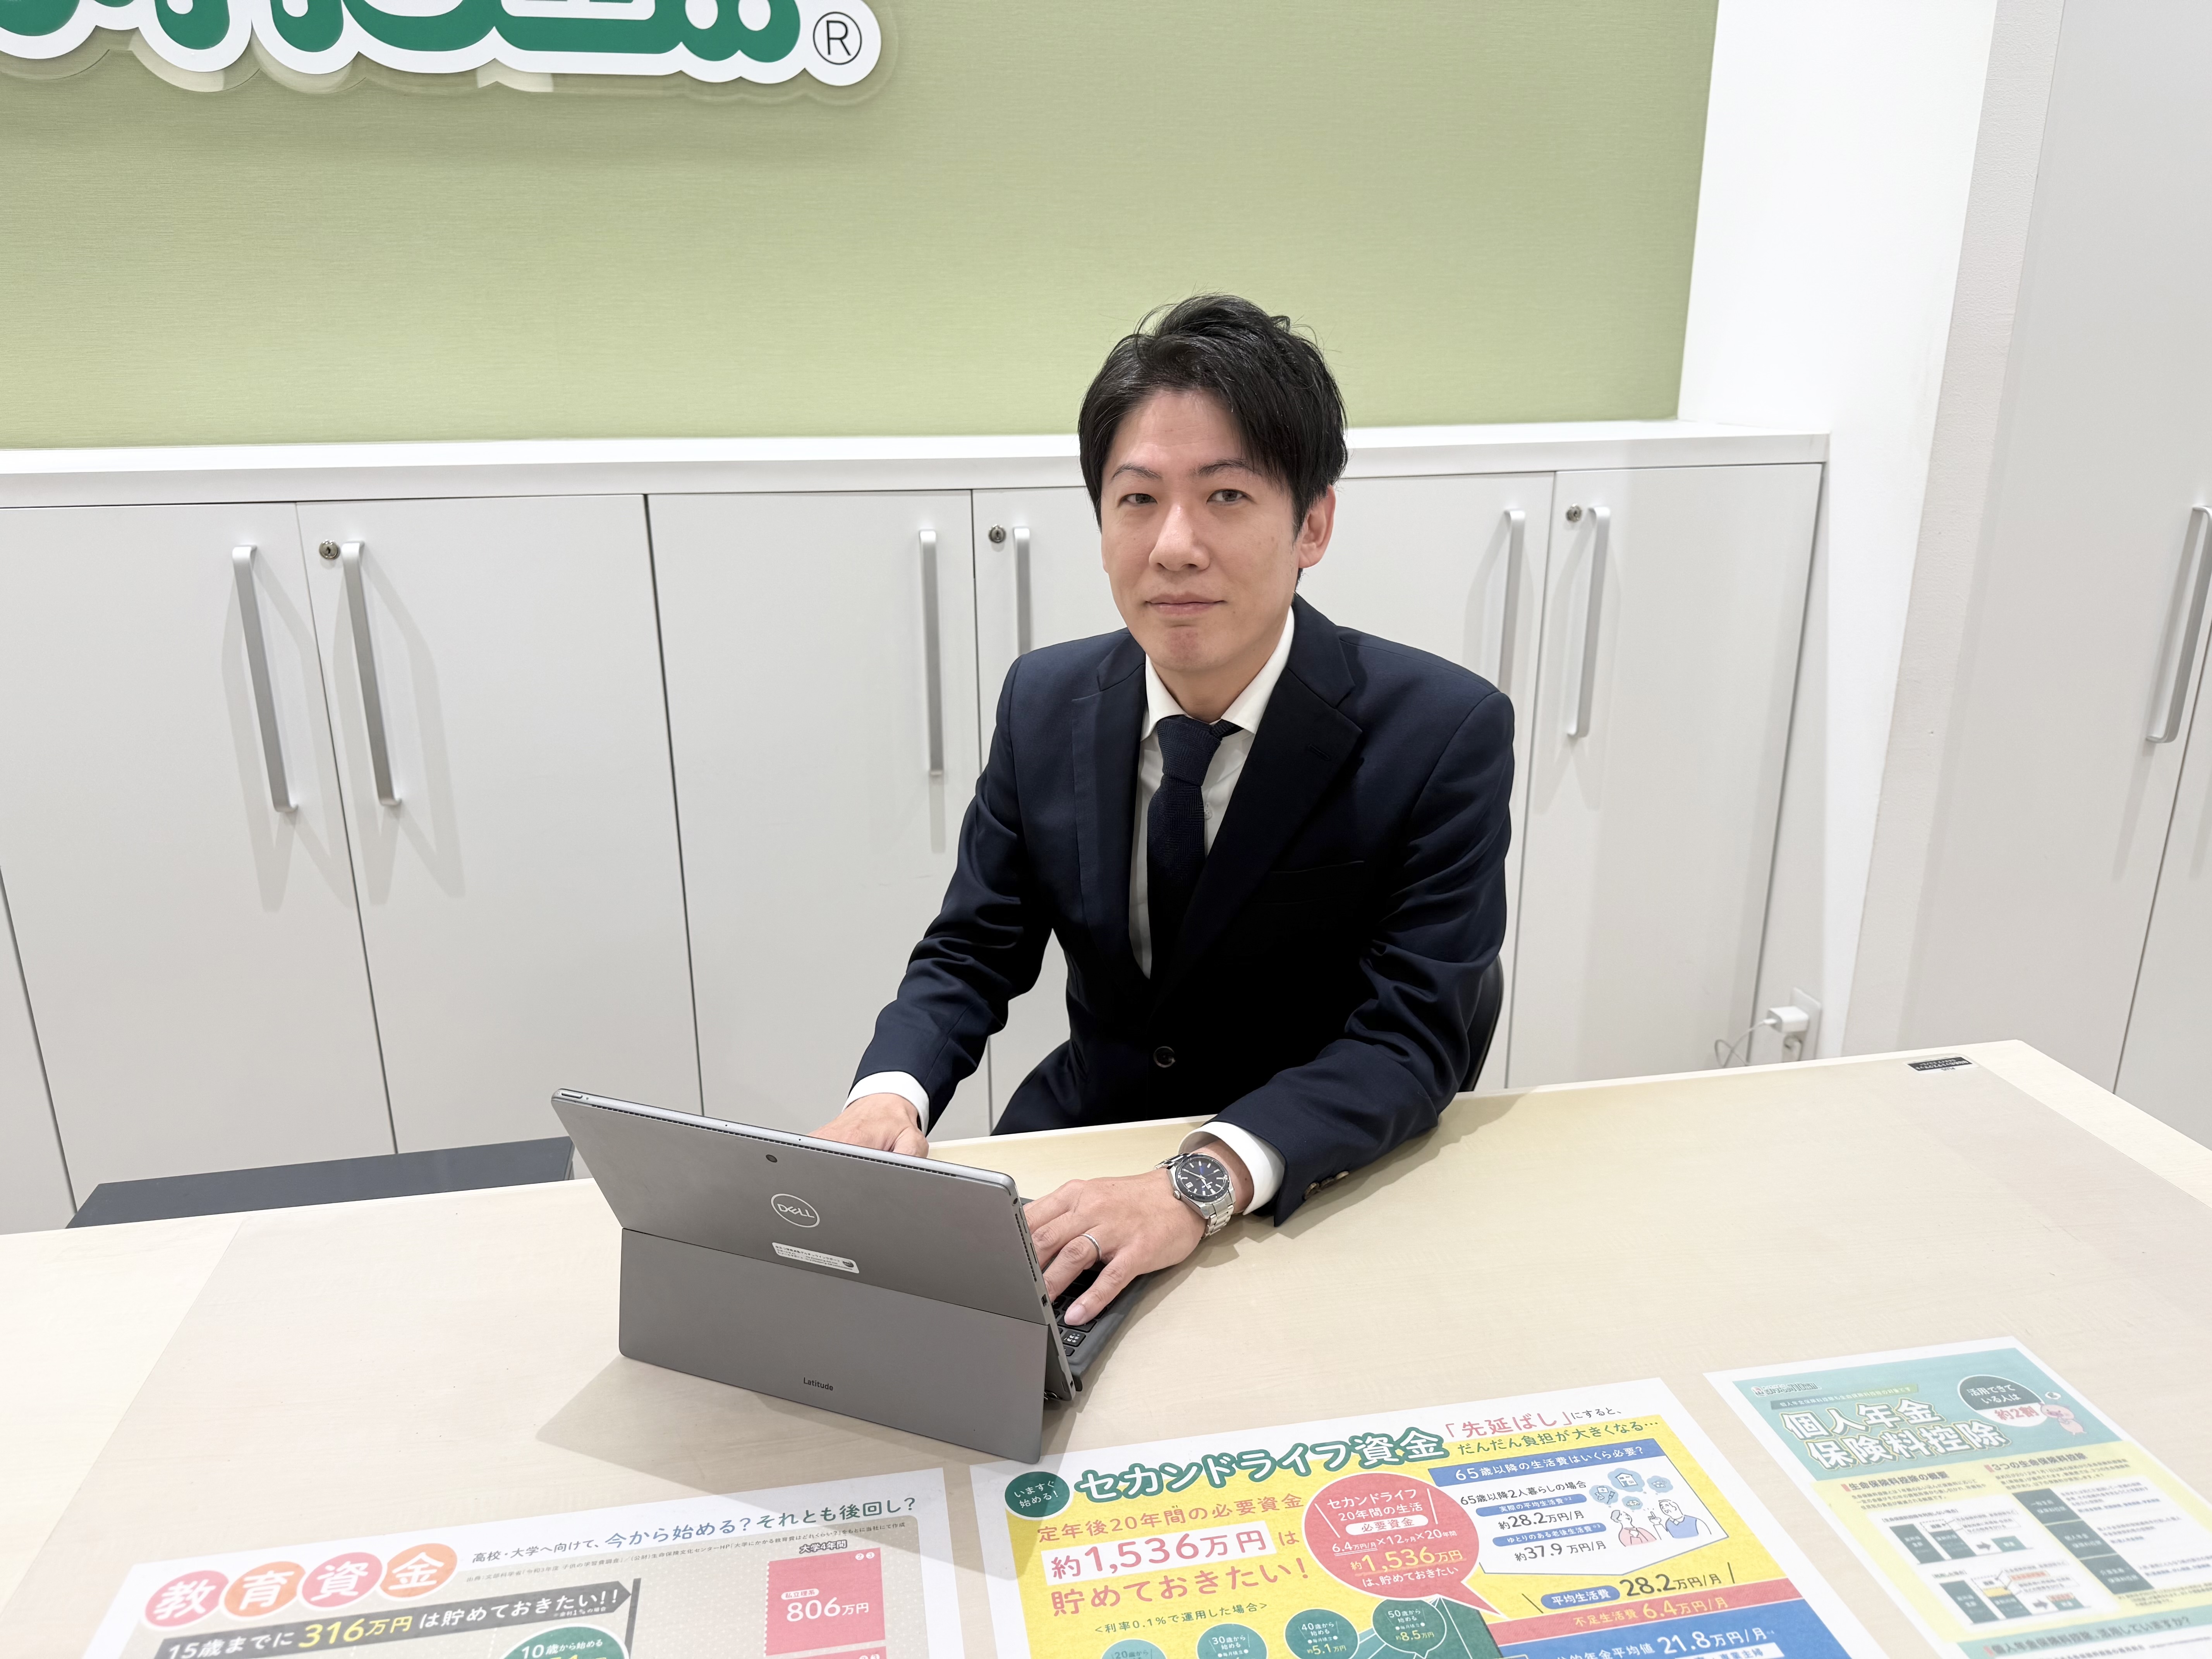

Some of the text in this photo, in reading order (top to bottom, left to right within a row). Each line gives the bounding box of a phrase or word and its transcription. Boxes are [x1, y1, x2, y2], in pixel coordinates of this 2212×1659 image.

[777, 1204, 815, 1218] DELL
[804, 1377, 833, 1391] Latitude
[1966, 1384, 2015, 1396] 活用できて
[1981, 1394, 2021, 1404] いる人は
[1781, 1399, 1943, 1440] 個人年金
[1995, 1406, 2040, 1420] 約2割
[1807, 1420, 2008, 1468] 保険料控除
[1076, 1429, 1448, 1501] セカンドライフ資金
[1455, 1446, 1643, 1481] 65歳以降の生活費はいくら必要？
[1014, 1480, 1054, 1498] いますぐ
[1460, 1480, 1586, 1506] 65歳以降2人暮らしの場合
[1019, 1491, 1058, 1508] 始める！
[1327, 1489, 1417, 1509] セカンドライフ
[1037, 1493, 1305, 1542] 定年後20年間の必要資金
[1338, 1502, 1423, 1521] 20年間の生活
[1498, 1511, 1584, 1530] 約28.2万円/月
[1362, 1518, 1414, 1532] 必要資金
[800, 1540, 847, 1553] 大学4年間
[1051, 1530, 1300, 1580] 約1,536万円は
[1350, 1546, 1463, 1572] 約1,536万円
[153, 1553, 445, 1620] 教育資金
[1051, 1558, 1309, 1616] 貯めておきたい！
[1363, 1568, 1458, 1587] は、貯めておきたい
[785, 1590, 815, 1598] 私立理系
[1552, 1573, 1721, 1606] 平均生活費 28.2万円/月
[787, 1597, 869, 1621] 806万円
[1388, 1609, 1420, 1618] 50歳から
[1574, 1597, 1728, 1627] 不足生活費 6.4万円/月
[1302, 1622, 1334, 1630] 40歳から
[522, 1639, 603, 1659] 10歳から始める
[1212, 1635, 1245, 1645] 30歳から
[1657, 1627, 1767, 1654] 21.8万円/月
